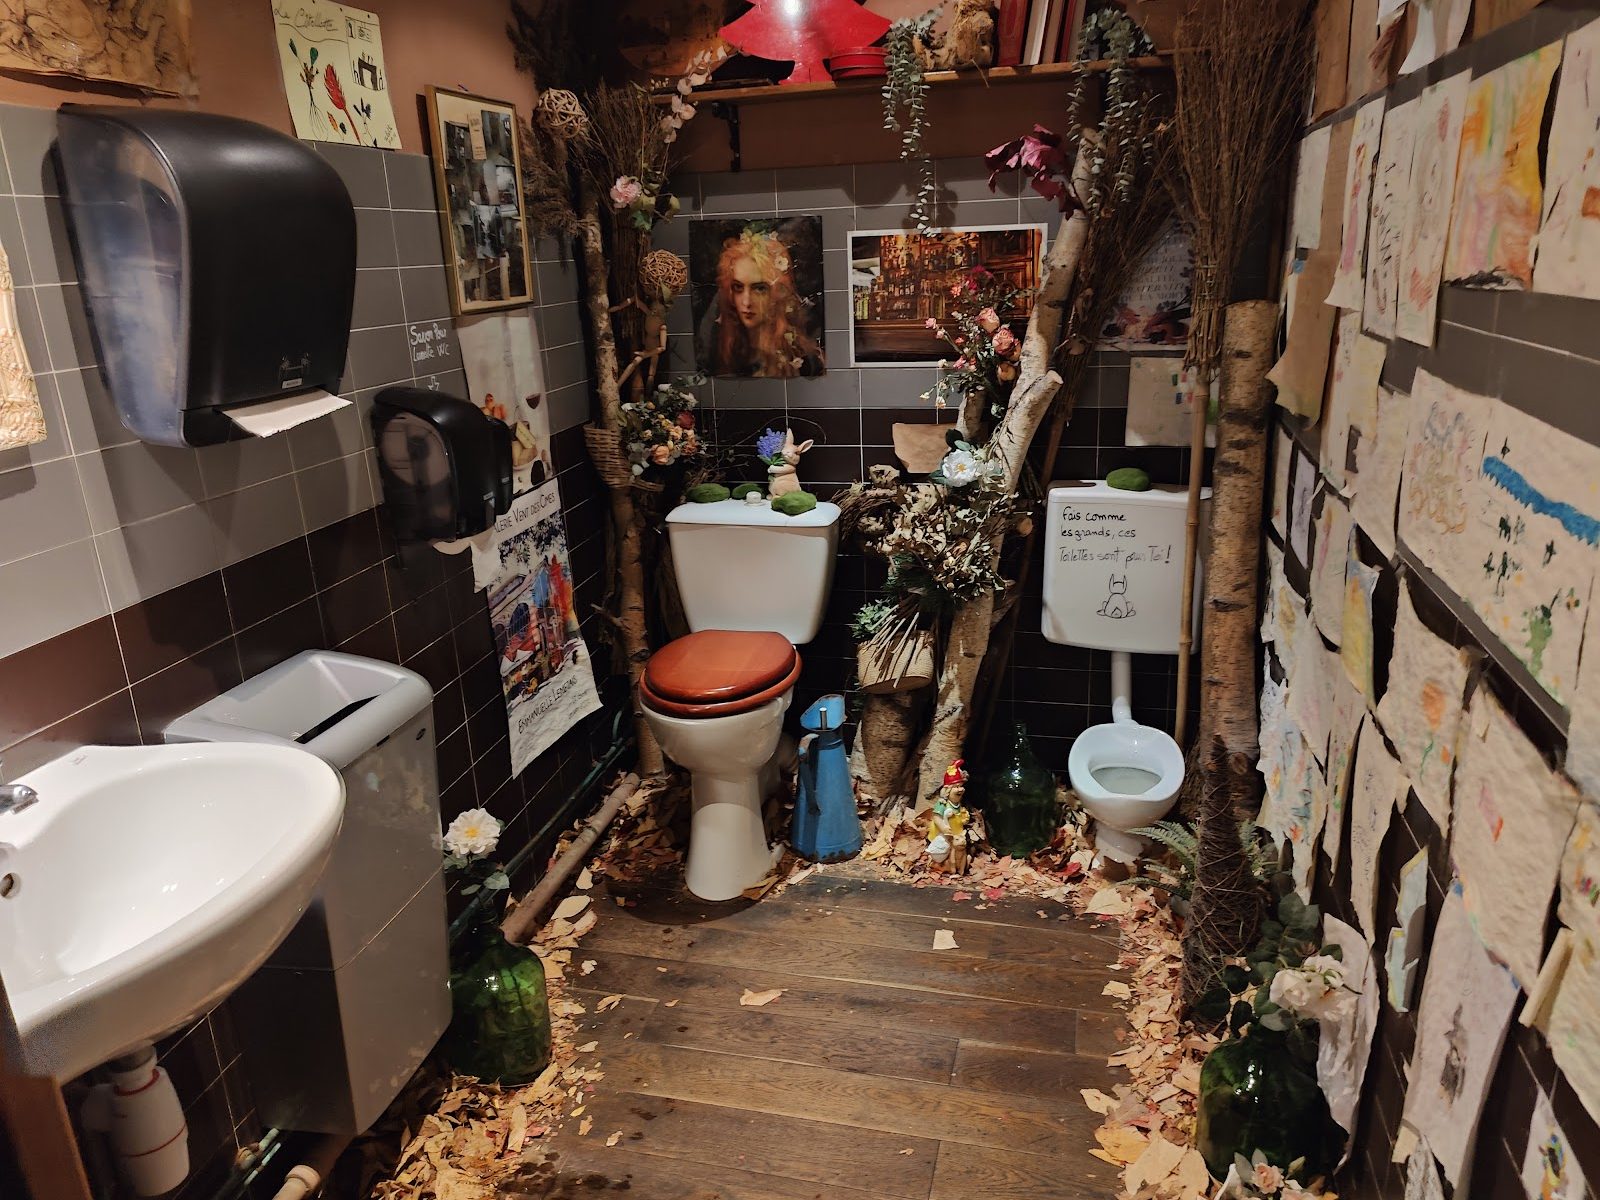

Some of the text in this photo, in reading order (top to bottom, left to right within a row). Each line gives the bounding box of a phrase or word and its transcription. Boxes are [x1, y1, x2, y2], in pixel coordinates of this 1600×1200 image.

[436, 343, 450, 357] WC
[1085, 512, 1127, 522] comme
[1118, 529, 1136, 538] ces
[1097, 546, 1124, 563] sont
